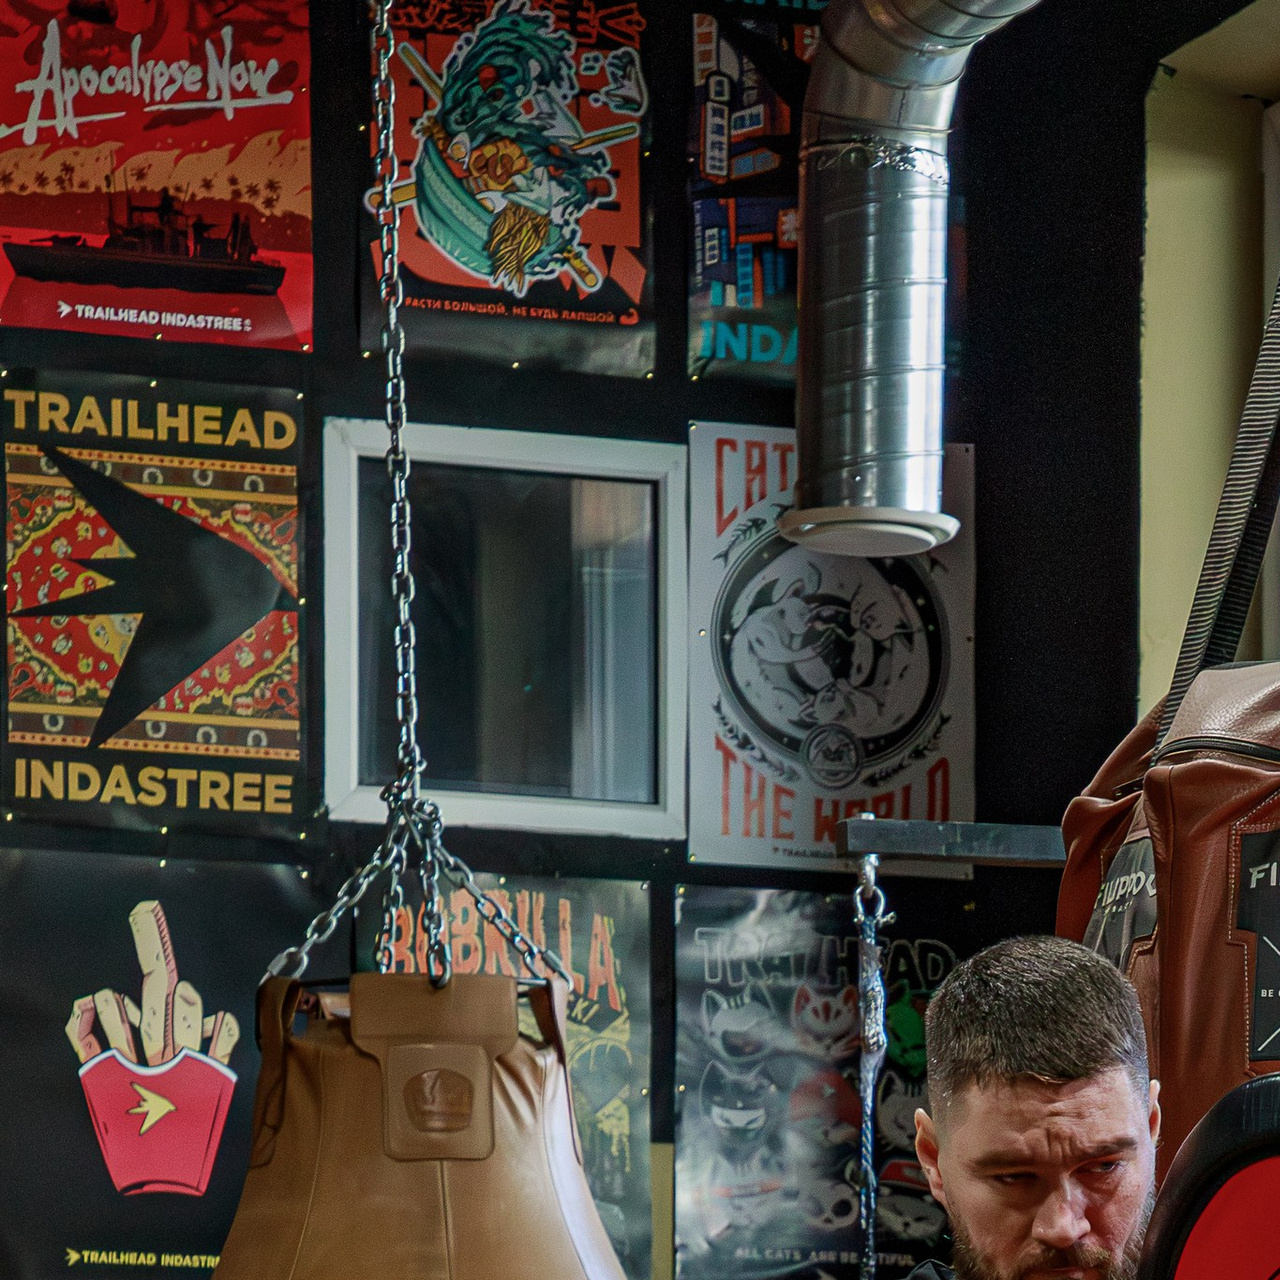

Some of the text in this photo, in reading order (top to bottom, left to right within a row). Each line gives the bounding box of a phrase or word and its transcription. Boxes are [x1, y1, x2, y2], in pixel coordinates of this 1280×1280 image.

[15, 18, 294, 145] Apocalypse Now
[74, 303, 160, 325] TRAILHEAD
[161, 311, 243, 332] INDASTREE
[512, 305, 527, 316] НЕ
[530, 307, 559, 320] БУДЬ
[4, 388, 297, 450] TRAILHEAD
[14, 757, 294, 815] INDASTREE
[714, 732, 796, 840] THE
[694, 927, 957, 994] TRAILHAD
[1260, 989, 1274, 998] BE
[81, 1250, 157, 1267] TRAILHEAD
